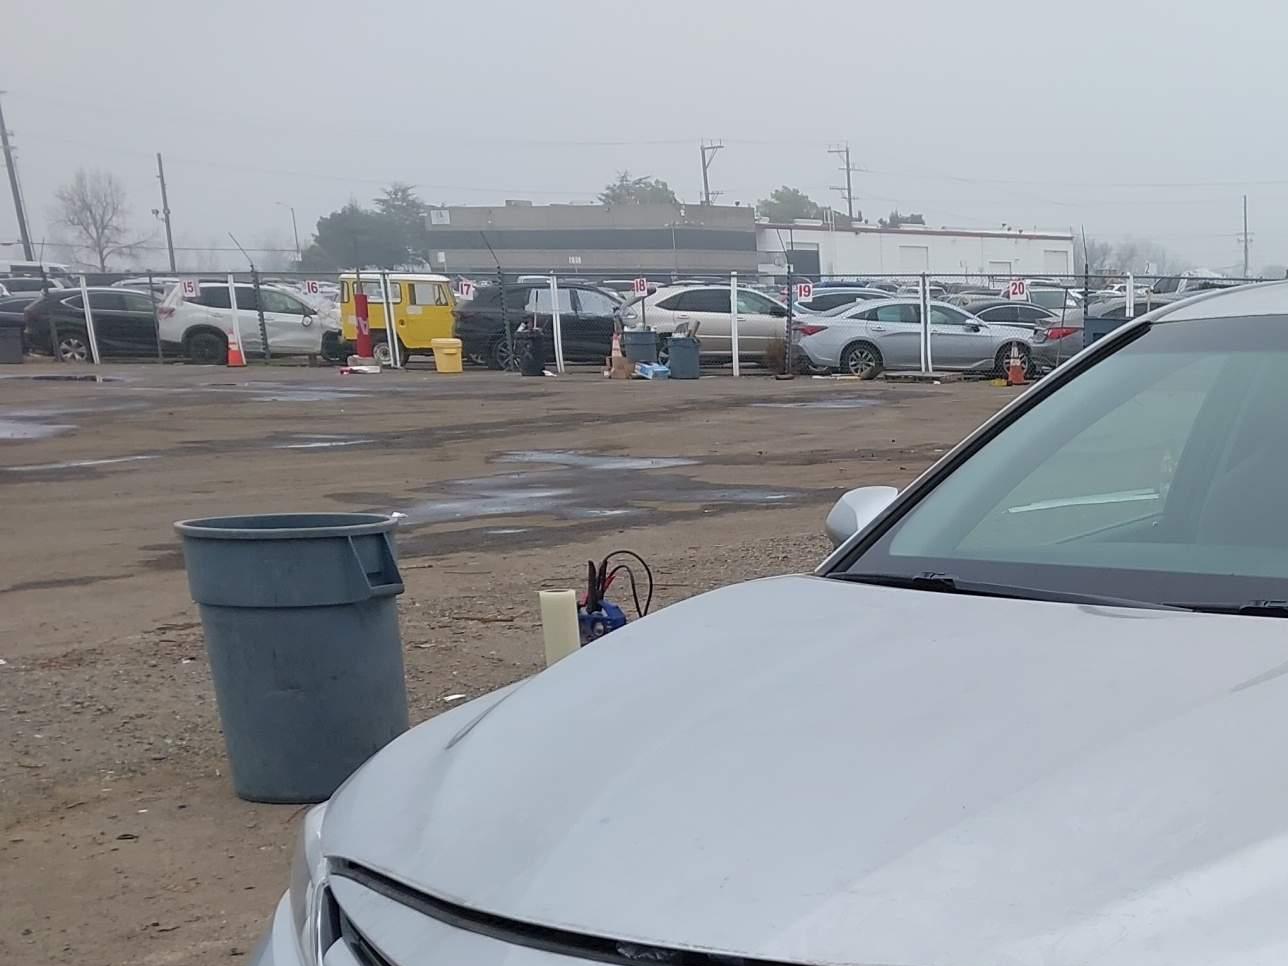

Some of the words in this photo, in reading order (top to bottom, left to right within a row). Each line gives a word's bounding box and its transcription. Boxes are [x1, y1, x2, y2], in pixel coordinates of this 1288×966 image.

[183, 281, 194, 293] 15
[307, 281, 318, 294] 16
[460, 283, 471, 295] 17
[635, 279, 646, 292] 18
[799, 285, 811, 298] 19
[1011, 282, 1025, 296] 20
